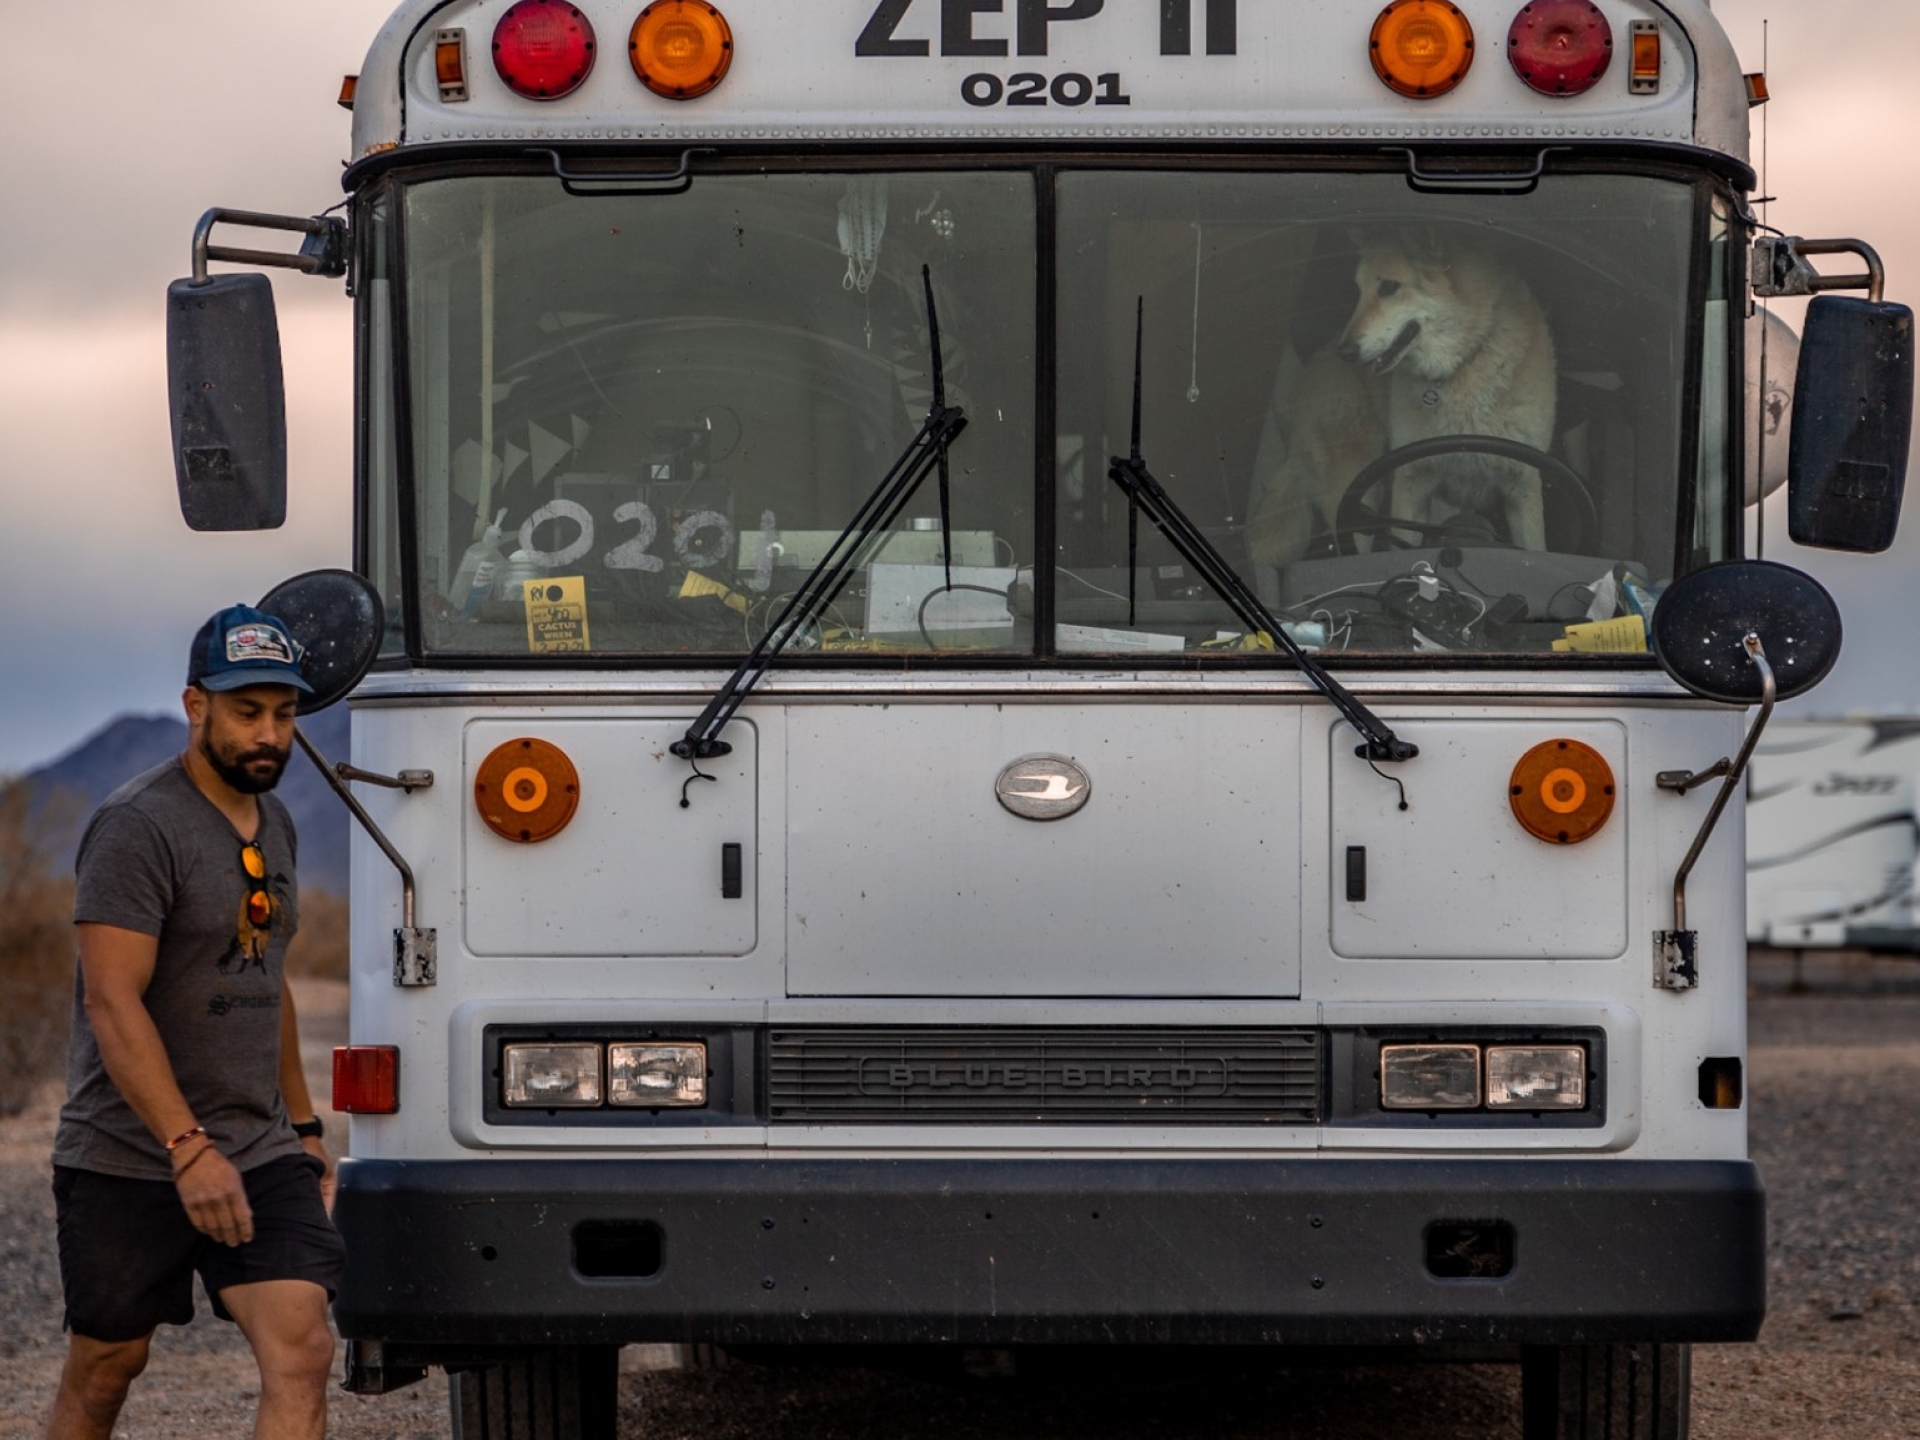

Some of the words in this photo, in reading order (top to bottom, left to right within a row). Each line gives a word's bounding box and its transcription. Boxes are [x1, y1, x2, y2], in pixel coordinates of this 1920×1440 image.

[855, 0, 1105, 58] ZEP
[960, 71, 1131, 106] 0201
[518, 499, 776, 592] 0201
[537, 621, 577, 632] CACTUS
[542, 630, 573, 641] WREN
[892, 1064, 1028, 1087] BLUE
[1065, 1064, 1197, 1087] BIRD
